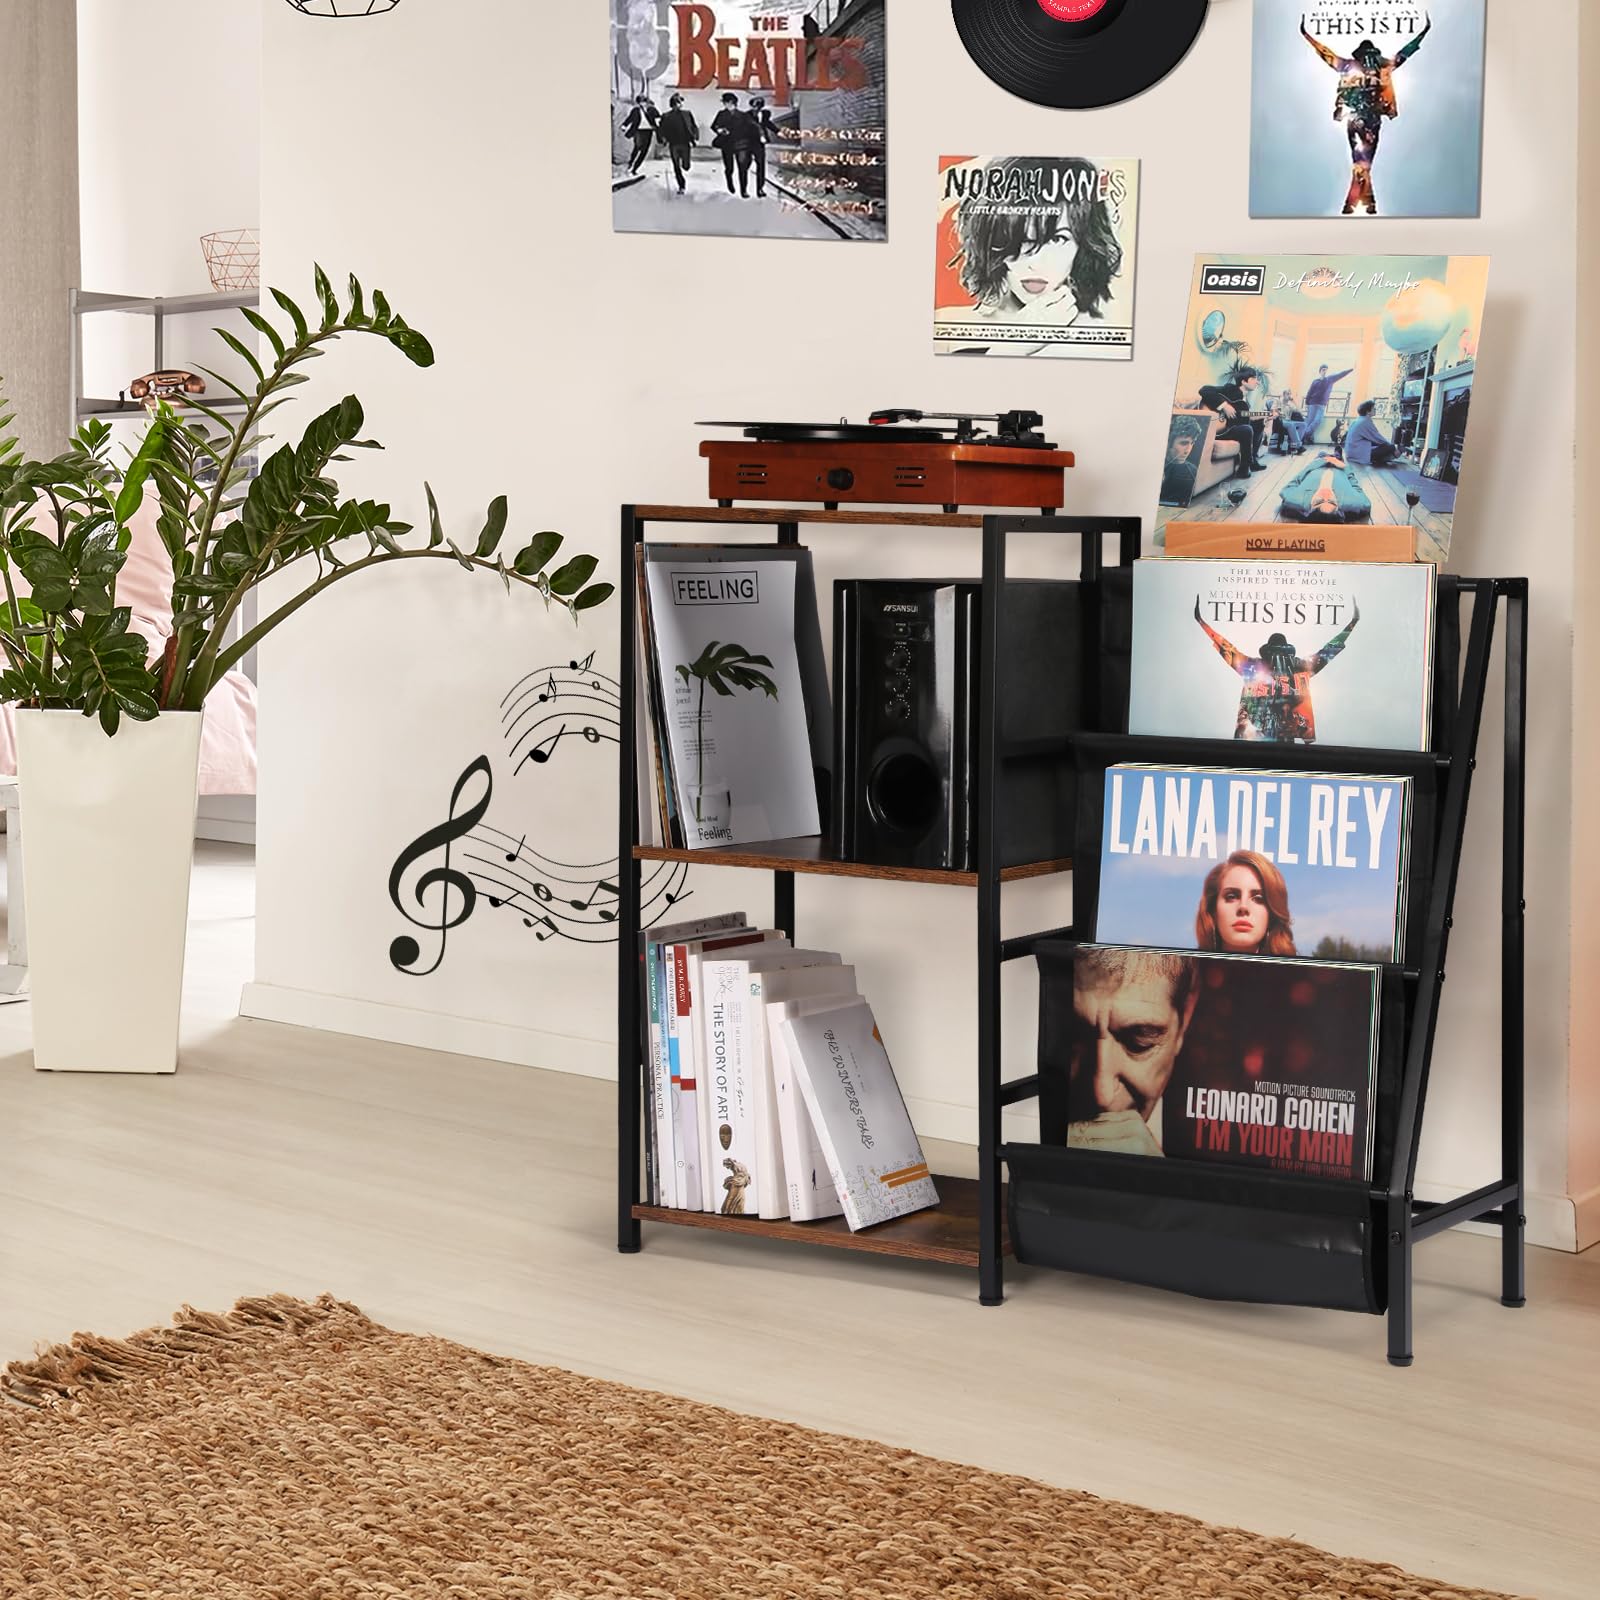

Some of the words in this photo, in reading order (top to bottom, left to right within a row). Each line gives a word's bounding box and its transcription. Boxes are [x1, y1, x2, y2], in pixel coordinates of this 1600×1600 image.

[750, 16, 788, 31] THE
[1310, 18, 1364, 35] THIS
[1371, 17, 1390, 34] IS
[1396, 17, 1420, 34] IT
[671, 4, 869, 107] BEATLES
[942, 167, 1044, 204] NORAH
[1042, 168, 1127, 206] JONES
[1207, 272, 1258, 287] oasis
[1272, 271, 1364, 298] Definitely
[1367, 271, 1421, 299] Maybe
[1246, 538, 1272, 549] NOW
[1277, 538, 1326, 550] PLAYING
[677, 578, 754, 600] FEELING
[1218, 576, 1269, 584] INSPIRED
[1275, 577, 1295, 585] THE
[1301, 578, 1337, 586] MOVIE
[1208, 590, 1269, 600] MICHAEL
[1275, 592, 1345, 602] JACKSON'S
[891, 604, 919, 613] SANSUI
[1207, 601, 1274, 623] THIS
[1282, 602, 1306, 625] IS
[1314, 604, 1345, 625] IT
[697, 826, 734, 841] Feeling
[1109, 774, 1217, 859] LANA
[1226, 780, 1299, 865] DEL
[1307, 784, 1392, 870] REY
[713, 1002, 724, 1028] THE
[654, 1041, 662, 1081] PERSONAL
[714, 1031, 726, 1073] STORY
[716, 1075, 727, 1093] OF
[1254, 1080, 1281, 1095] MOTION
[1282, 1083, 1309, 1098] PICTURE
[1311, 1086, 1356, 1103] SOUNDTRACK
[656, 1083, 664, 1120] PRACTICE
[718, 1095, 729, 1121] ART
[1186, 1086, 1278, 1127] LEONARD
[1283, 1097, 1356, 1135] COHEN
[1195, 1118, 1231, 1152] I'M
[1238, 1123, 1295, 1159] YOUR
[1298, 1130, 1353, 1167] MAN
